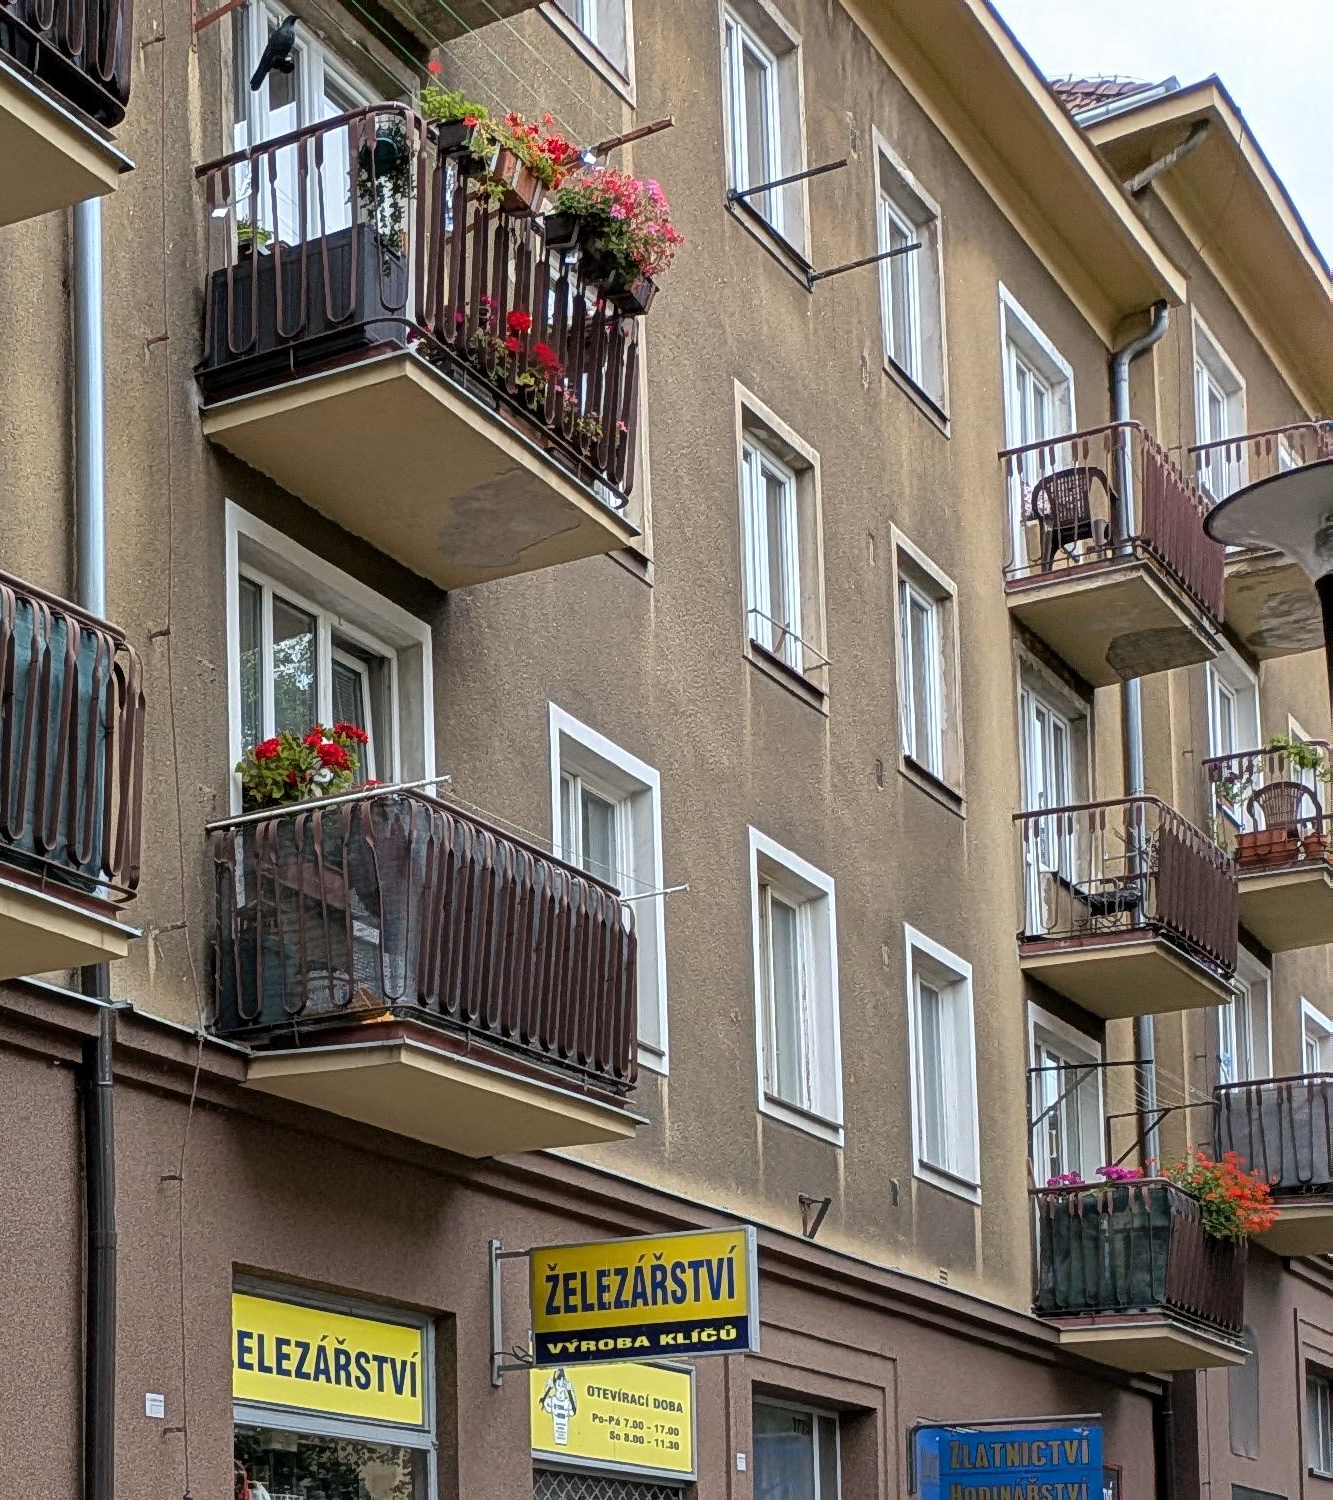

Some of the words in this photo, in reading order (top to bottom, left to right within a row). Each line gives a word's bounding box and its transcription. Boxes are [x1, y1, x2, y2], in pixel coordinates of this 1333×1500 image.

[545, 1245, 737, 1316] ŽELEZÁŘSTVÍ
[547, 1336, 651, 1355] VÝROBA
[659, 1324, 738, 1346] KLÍČŮ
[233, 1329, 419, 1398] ELEZÁŘSTVÍ
[587, 1385, 650, 1407] OTEVÍRACÍ
[653, 1398, 683, 1413] DOBA
[592, 1413, 621, 1426] Po-Pá
[623, 1418, 644, 1430] 7.00
[654, 1424, 680, 1436] 17.00
[609, 1430, 621, 1440] So
[624, 1433, 644, 1444] 8.00
[654, 1439, 680, 1450] 11.30
[949, 1430, 1090, 1468] ZLATNICTVÍ
